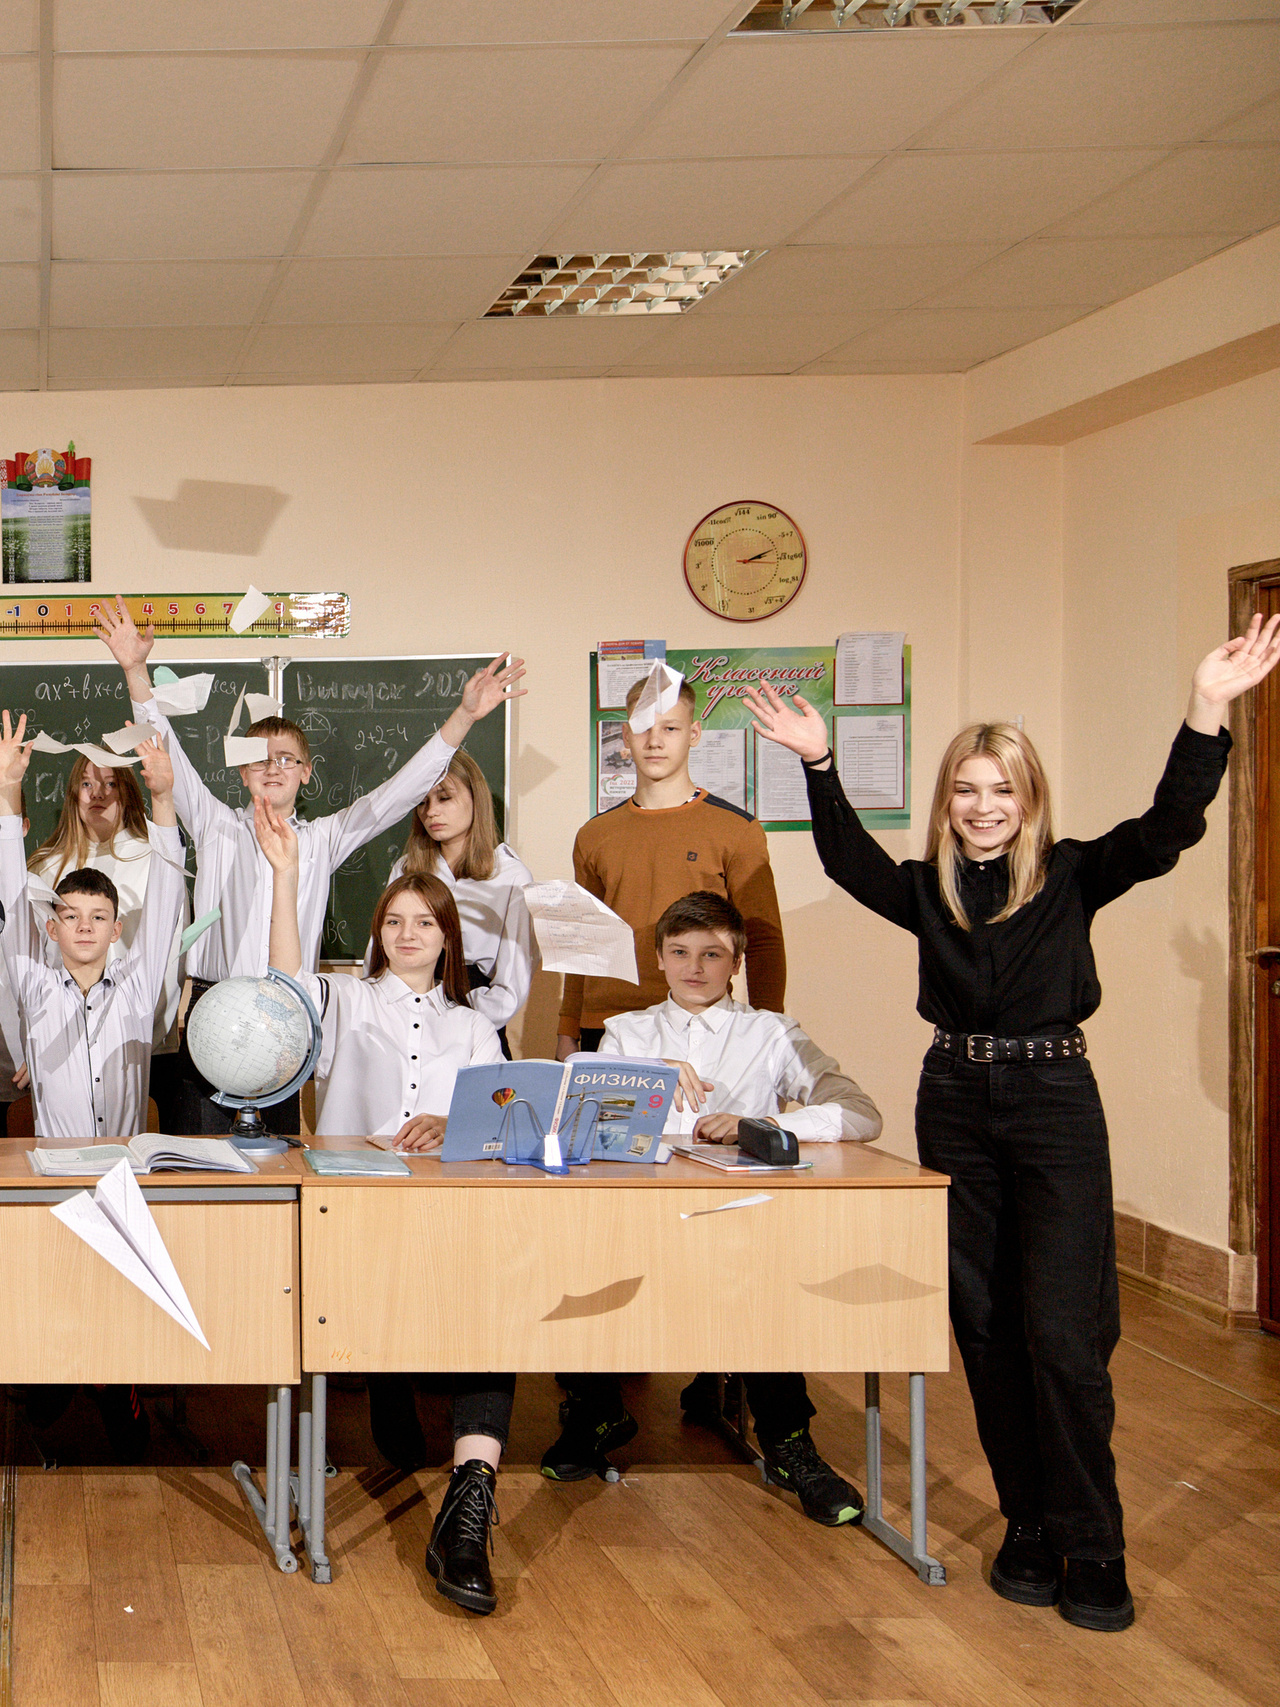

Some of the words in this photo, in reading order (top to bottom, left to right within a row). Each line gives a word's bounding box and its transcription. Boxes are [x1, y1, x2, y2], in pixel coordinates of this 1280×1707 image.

[6, 605, 21, 617] -1
[37, 604, 48, 617] 0
[64, 604, 72, 616] 1
[89, 604, 100, 616] 2
[142, 603, 154, 615] 4
[168, 603, 179, 615] 5
[195, 602, 206, 615] 6
[222, 602, 234, 615] 7
[686, 655, 826, 683] Классный
[701, 683, 800, 720] угоок
[354, 722, 409, 751] 2+2=4
[574, 1073, 666, 1091] ФИЗИКА
[648, 1094, 664, 1109] 9
